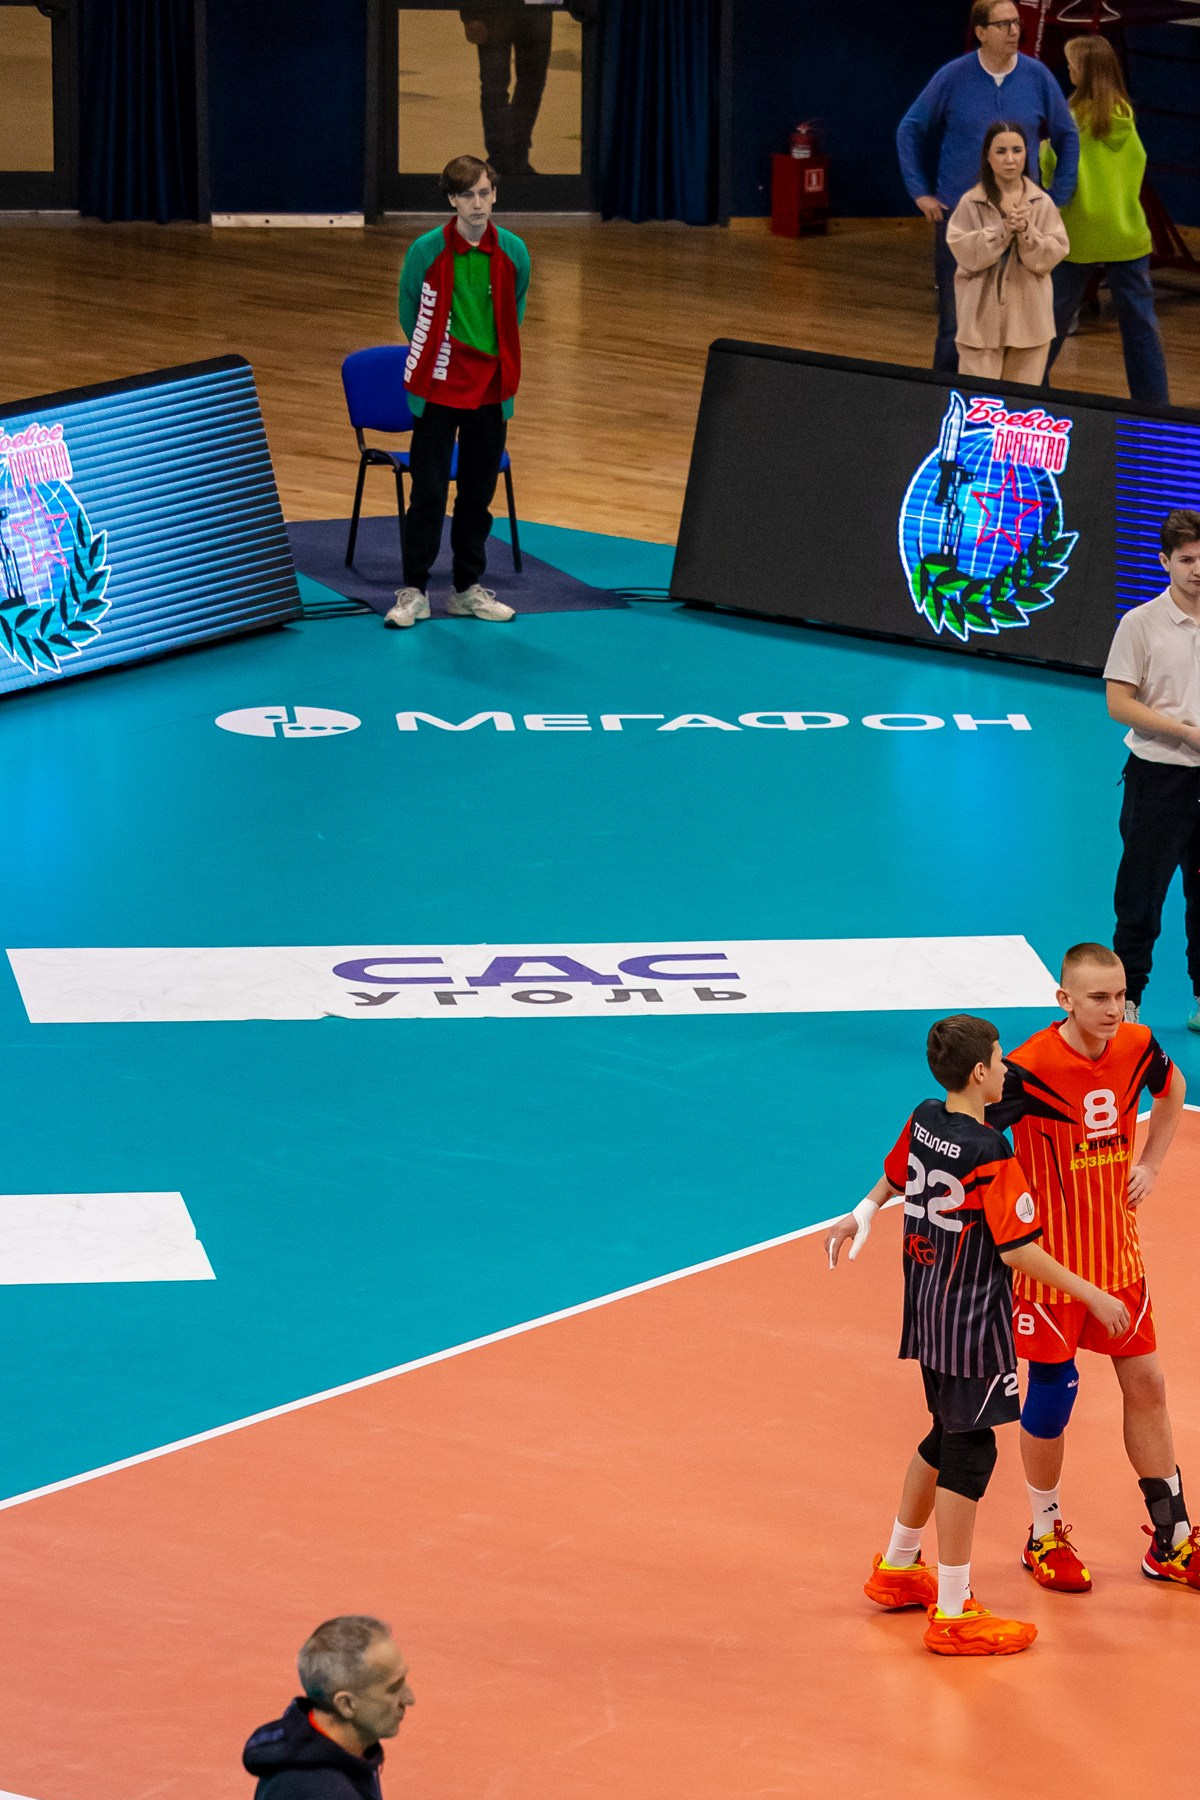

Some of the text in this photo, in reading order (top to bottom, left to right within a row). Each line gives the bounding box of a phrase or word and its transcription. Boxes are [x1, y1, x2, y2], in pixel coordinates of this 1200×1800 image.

[404, 281, 438, 383] ВОЛОНТЕР
[966, 399, 1070, 433] Боевое
[0, 423, 63, 451] оевое
[396, 711, 1033, 731] МЕГАФОН
[332, 952, 741, 988] СДС
[346, 986, 748, 1007] УГОЛЬ
[1083, 1088, 1118, 1130] 8
[903, 1152, 966, 1233] 22
[1017, 1313, 1035, 1336] 8
